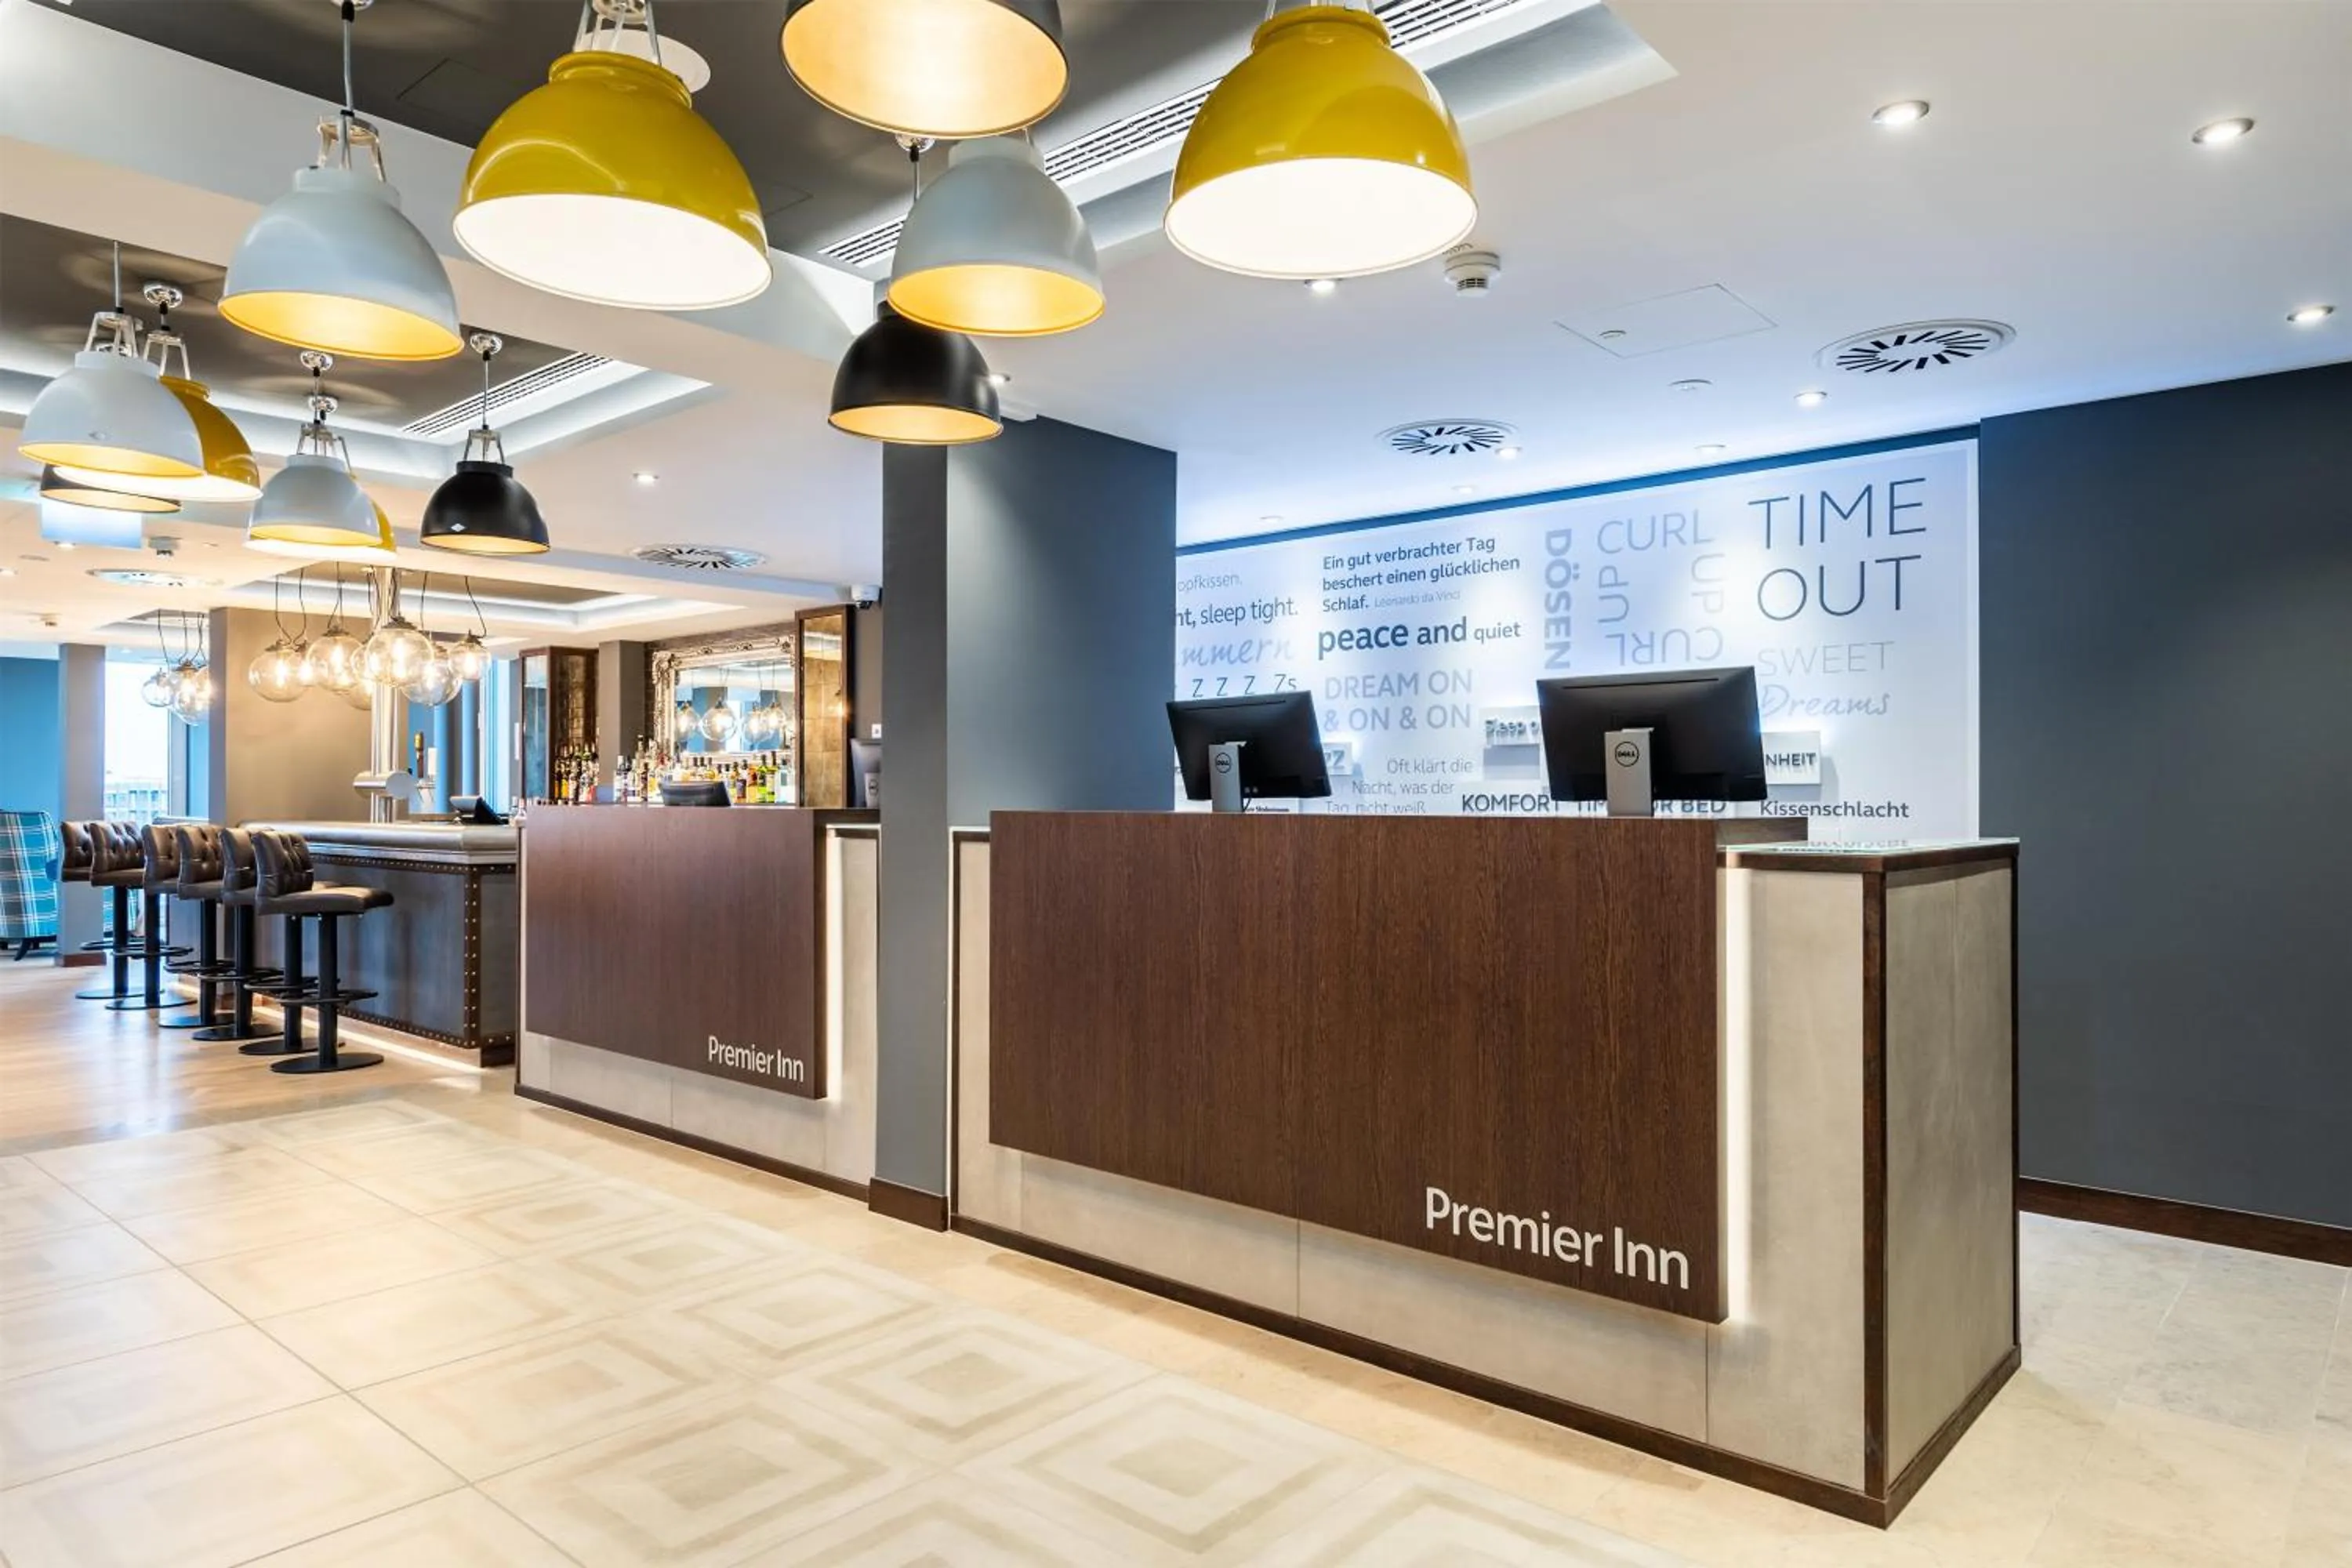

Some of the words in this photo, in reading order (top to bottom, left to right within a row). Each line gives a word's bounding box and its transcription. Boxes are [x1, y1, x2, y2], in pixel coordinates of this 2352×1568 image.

[1748, 477, 1926, 549] TIME
[1597, 509, 1716, 554] CURL
[1323, 556, 1345, 570] Ein
[1348, 552, 1372, 570] gut
[1374, 541, 1462, 564] verbrachter
[1466, 536, 1496, 554] Tag
[1177, 575, 1243, 593] opfkissen.
[1323, 572, 1383, 591] beschert
[1386, 568, 1427, 584] einen
[1430, 557, 1520, 583] glücklichen
[1691, 552, 1726, 614] UP
[1758, 554, 1922, 620] OUT
[1323, 593, 1370, 612] Schlaf.
[1544, 528, 1581, 670] DÖSEN
[1598, 564, 1629, 623] UP
[1200, 603, 1246, 626] sleep
[1250, 597, 1298, 624] tight.
[1318, 623, 1410, 660] peace
[1417, 616, 1467, 645] and
[1474, 621, 1523, 644] quiet
[1605, 626, 1723, 666] CURL
[1758, 641, 1896, 677] SWEET
[1324, 672, 1420, 700] DREAM
[1428, 669, 1473, 695] ON
[1761, 684, 1891, 718] Dreams
[1323, 709, 1340, 733] &
[1348, 706, 1390, 731] ON
[1399, 705, 1418, 730] &
[1427, 703, 1471, 729] ON
[1387, 757, 1410, 774] Oft
[1450, 758, 1474, 773] die
[1765, 751, 1817, 767] NHEIT
[1400, 783, 1428, 795] was
[1431, 779, 1455, 794] der
[1759, 798, 1910, 818] Kissenschlacht
[708, 1035, 775, 1075] Premier
[777, 1048, 804, 1083] Inn
[1426, 1186, 1603, 1268] Premier
[1613, 1226, 1689, 1290] Inn
